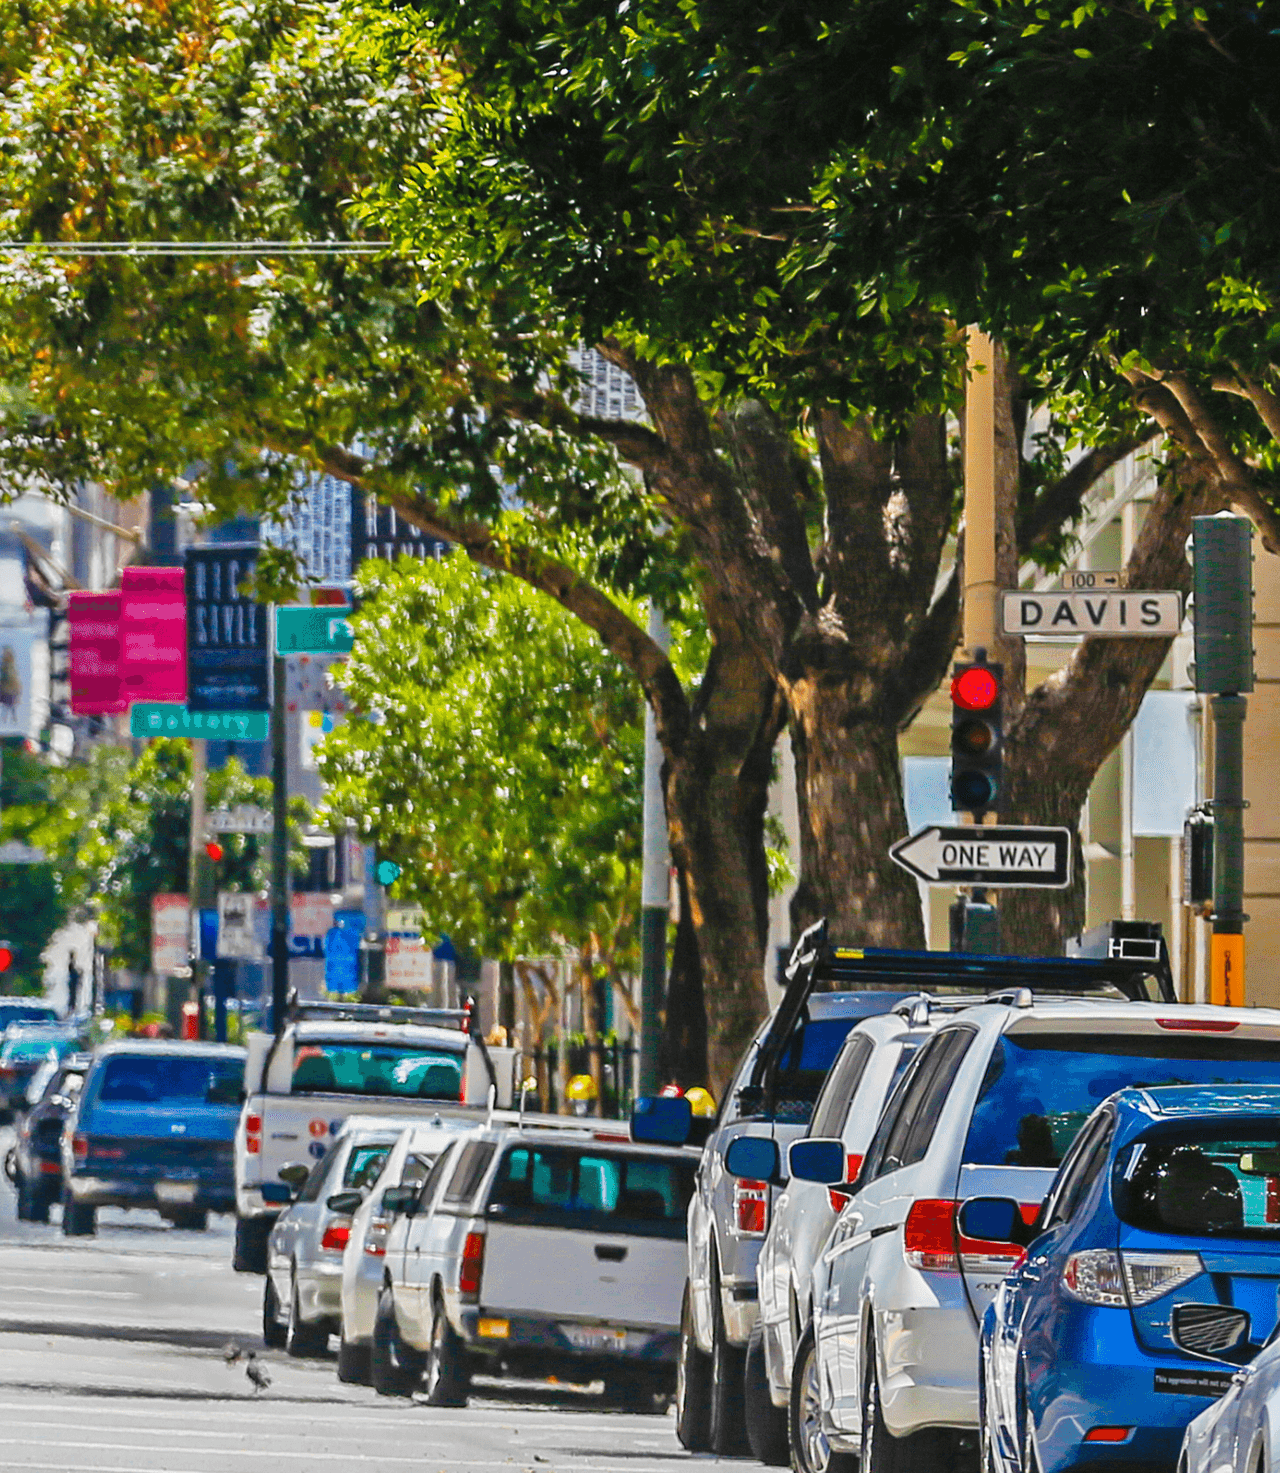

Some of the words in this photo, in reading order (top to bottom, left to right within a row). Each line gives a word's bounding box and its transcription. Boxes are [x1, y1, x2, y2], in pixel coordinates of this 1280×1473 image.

[1070, 574, 1095, 587] 100
[1020, 599, 1162, 626] DAVIS
[942, 844, 990, 866] ONE
[998, 844, 1049, 866] WAY
